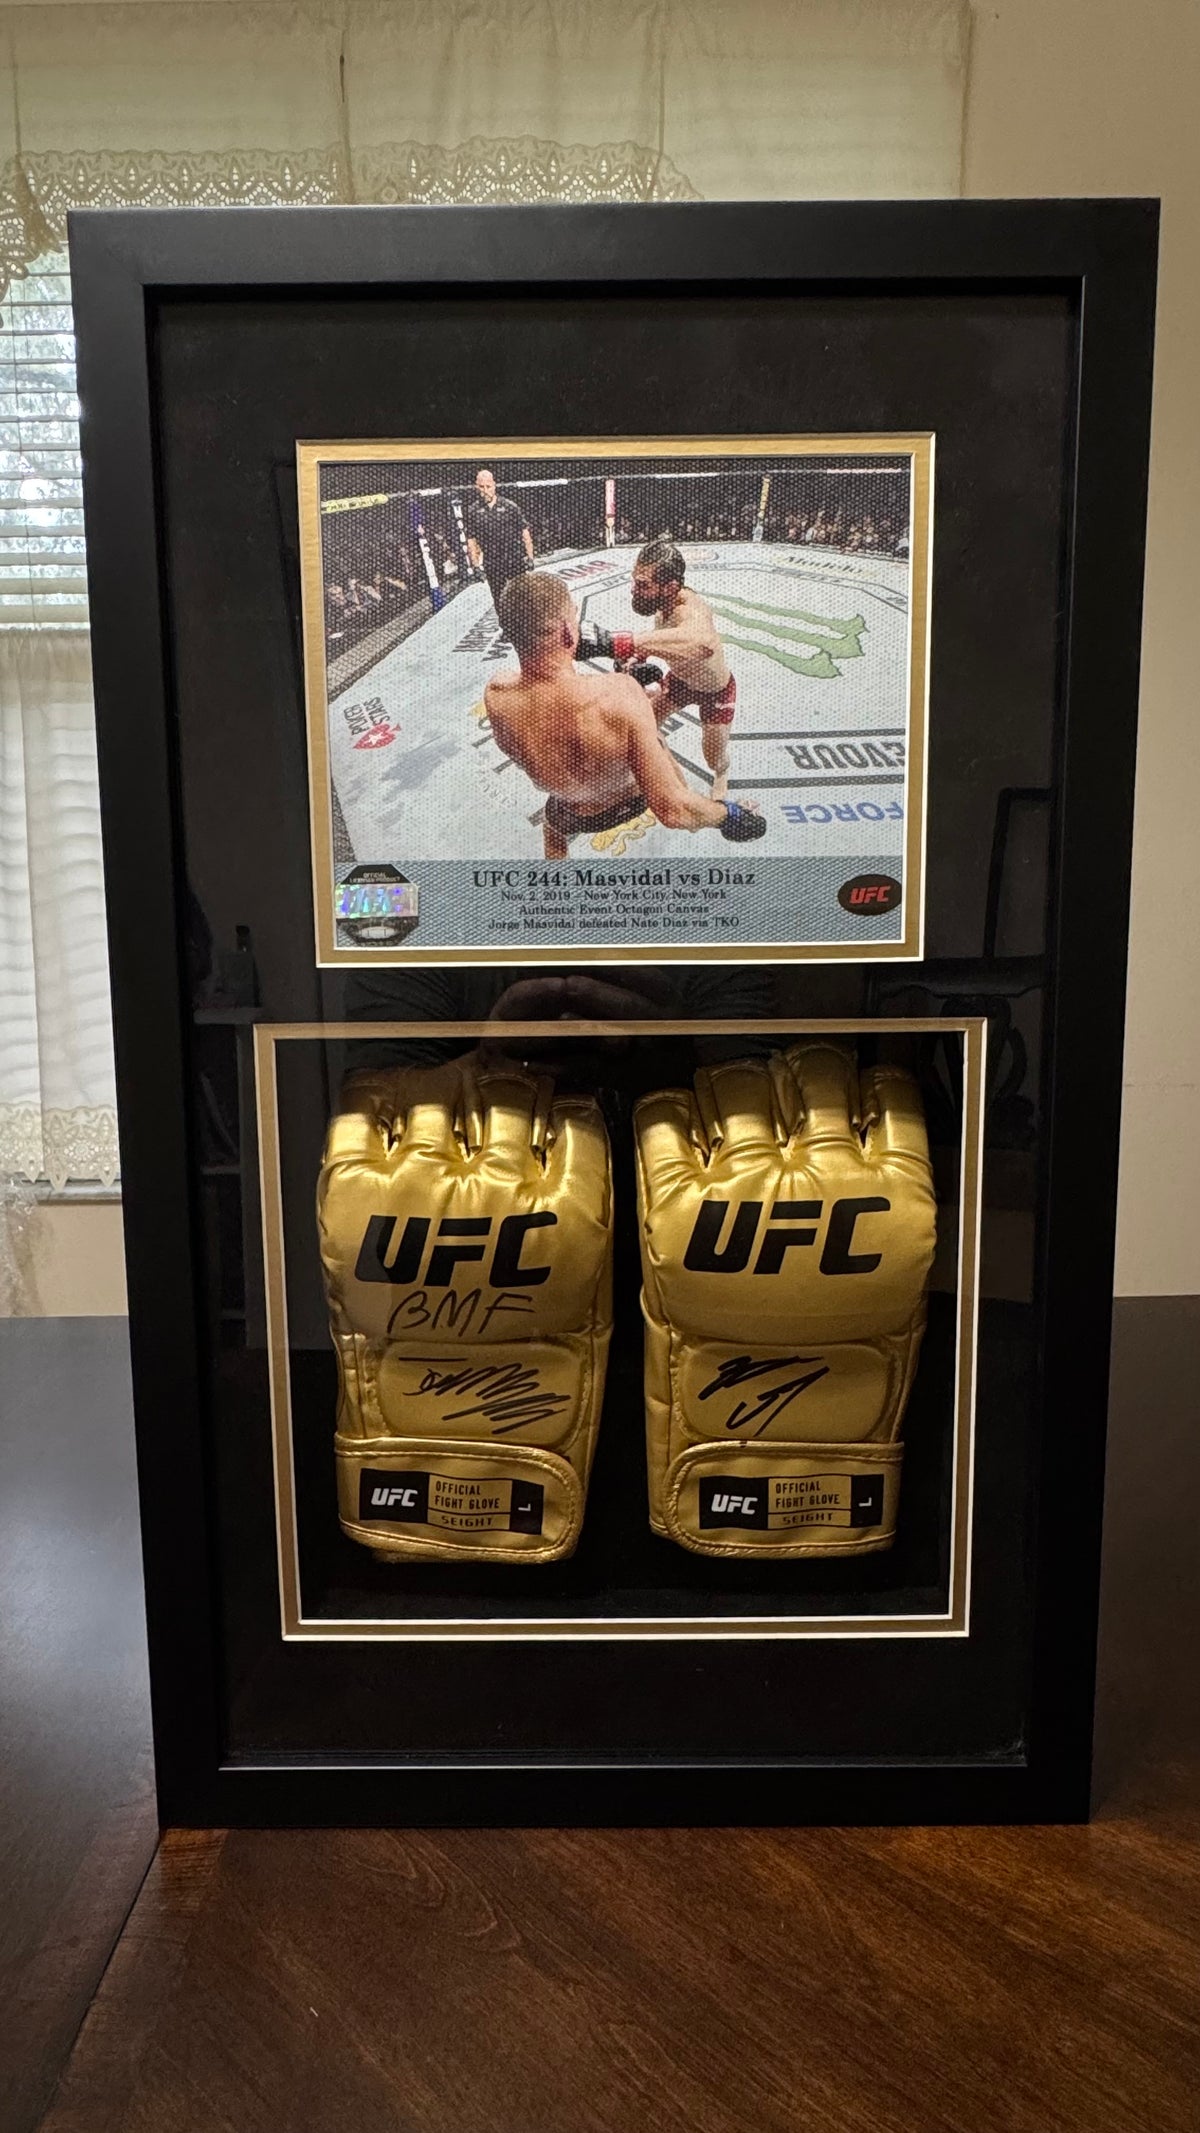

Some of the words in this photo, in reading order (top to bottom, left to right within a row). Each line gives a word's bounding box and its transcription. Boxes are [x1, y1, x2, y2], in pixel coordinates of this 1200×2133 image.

[363, 696, 391, 727] STARS
[780, 802, 905, 823] FORCE
[473, 870, 520, 888] UFC
[527, 871, 568, 887] 244:
[574, 868, 671, 887] Masvidal
[678, 873, 700, 886] vs
[706, 868, 756, 885] Diaz
[543, 890, 571, 901] 2019
[584, 890, 611, 901] New
[612, 889, 639, 900] York
[672, 888, 698, 899] New
[701, 888, 727, 899] York
[849, 886, 891, 904] UFC
[519, 905, 576, 915] Authentic
[580, 905, 613, 914] Event
[616, 903, 663, 916] Octagon
[667, 902, 710, 914] Canvas
[488, 920, 520, 931] Jorge
[523, 919, 576, 929] Masvidal
[579, 918, 627, 929] defeated
[631, 918, 659, 928] Nate
[662, 917, 689, 928] Diaz
[692, 917, 709, 927] via
[713, 916, 741, 927] TKO
[684, 1196, 891, 1275] UFC
[354, 1210, 558, 1288] UFC
[386, 1288, 536, 1337] BMF
[435, 1480, 481, 1496] OFFICIAL
[775, 1480, 821, 1495] OFFICIAL
[371, 1488, 418, 1507] UFC
[434, 1495, 463, 1509] FIGHT
[469, 1498, 500, 1509] GLOVE
[711, 1494, 758, 1515] UFC
[775, 1497, 804, 1509] FIGHT
[808, 1493, 841, 1506] GLOVE
